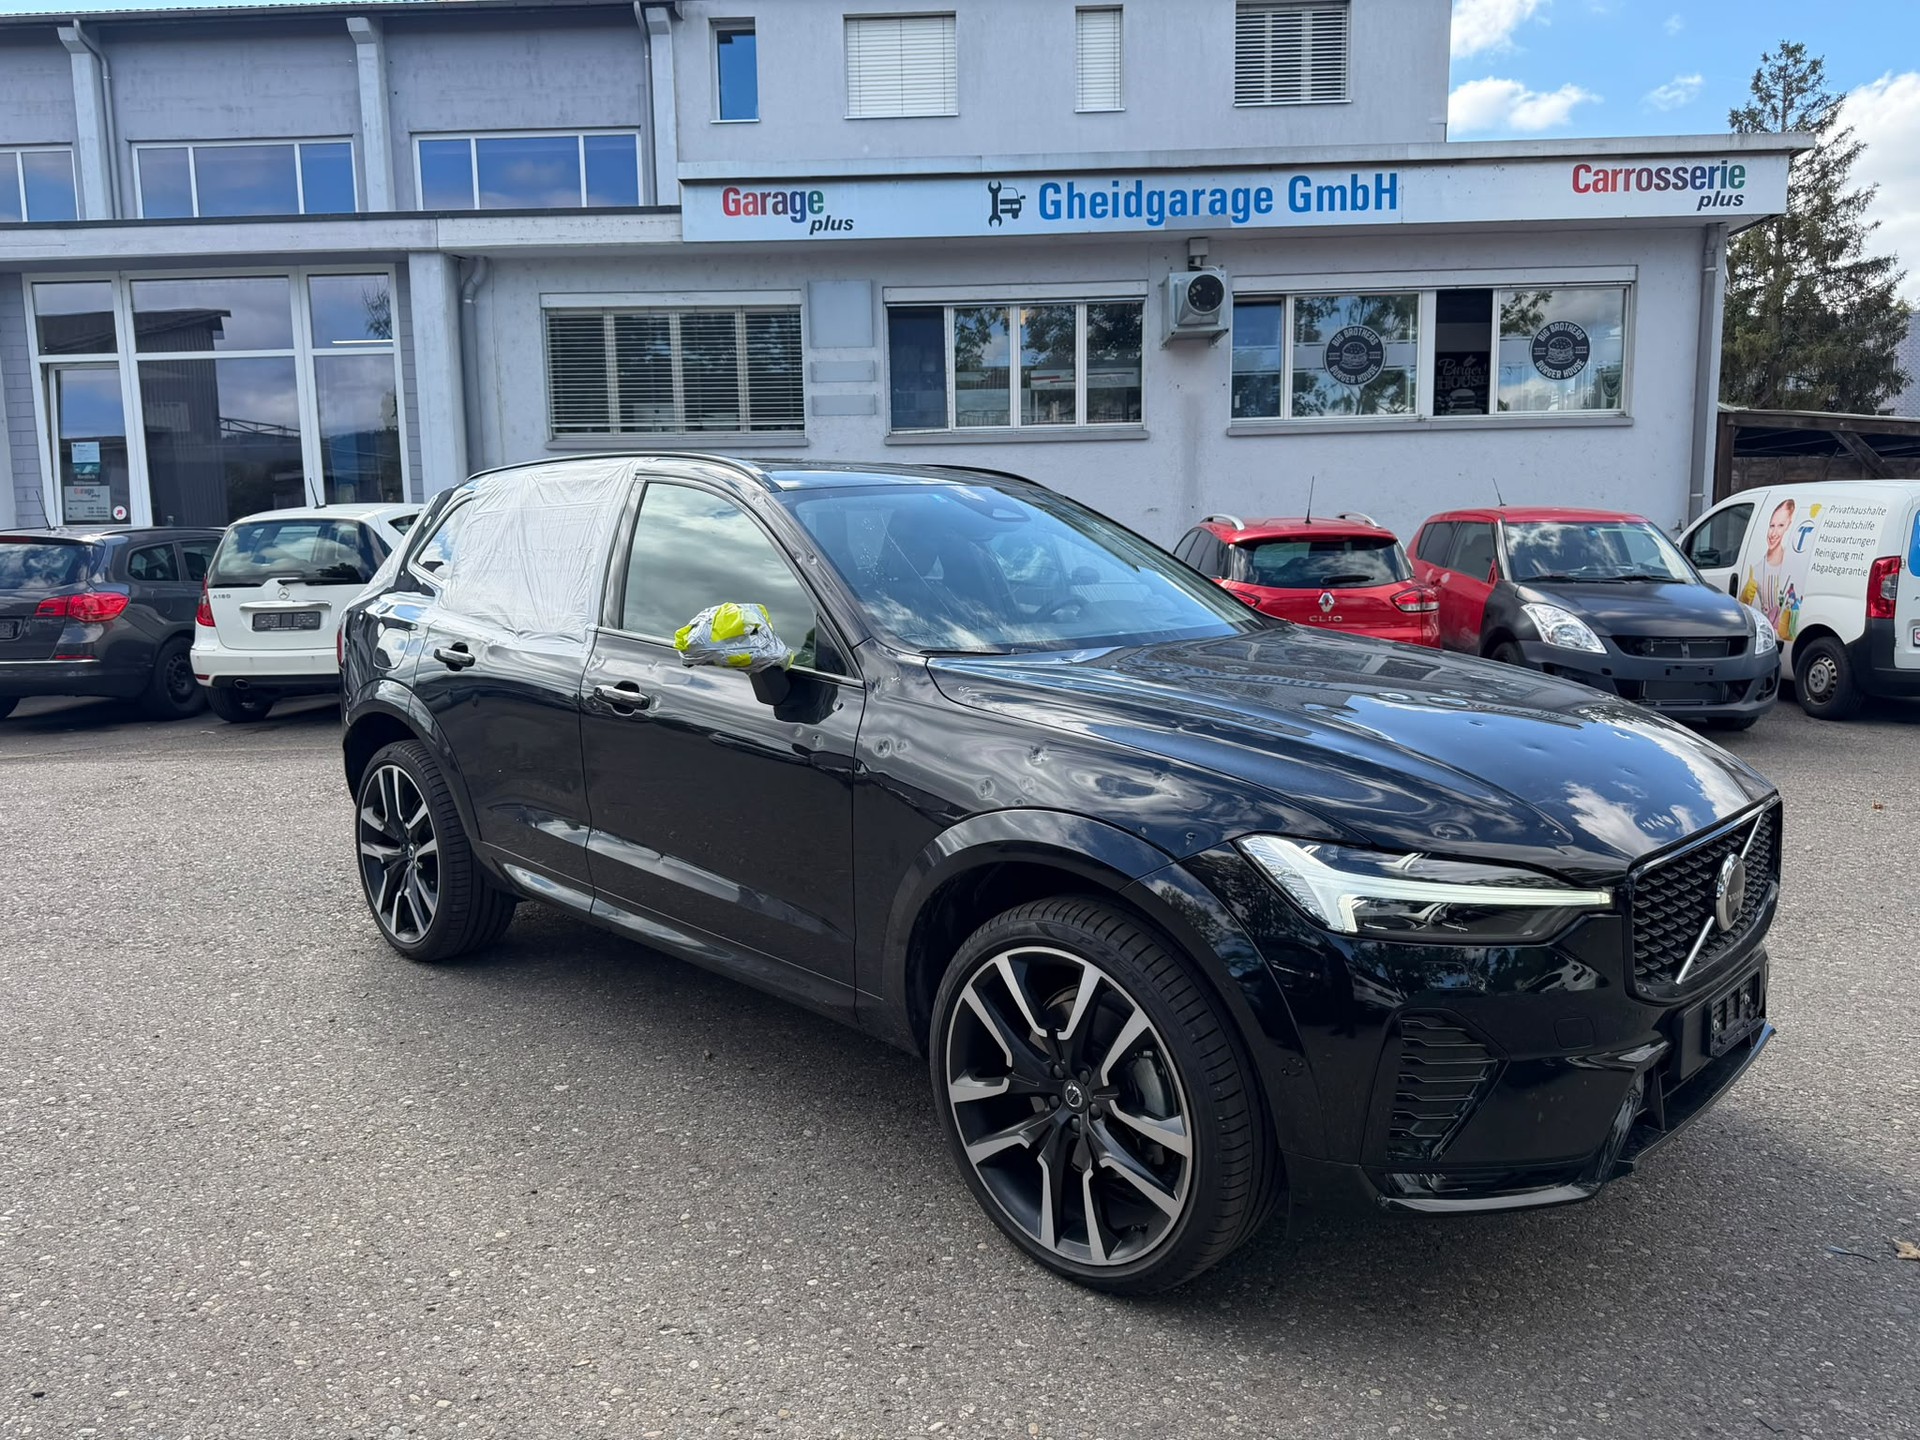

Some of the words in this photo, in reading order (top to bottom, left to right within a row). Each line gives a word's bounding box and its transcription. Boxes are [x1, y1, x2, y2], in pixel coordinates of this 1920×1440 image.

[1572, 159, 1747, 194] Carrosserie
[722, 186, 825, 224] Garage
[1038, 180, 1274, 227] Gheidgarage
[1287, 172, 1398, 214] GmbH
[1696, 190, 1745, 212] plus
[809, 214, 854, 236] plus
[1331, 332, 1345, 347] BIG
[1342, 326, 1379, 346] BROTHERS
[1537, 328, 1551, 342] BIG
[1548, 322, 1586, 341] BROTHERS
[1329, 364, 1357, 384] BURGER
[1356, 363, 1379, 383] HOUSE
[1535, 359, 1562, 379] BURGER
[1562, 357, 1586, 378] HOUSE
[1828, 504, 1887, 516] Privathaushalte
[1822, 519, 1875, 531] Haushaltshilfe
[1818, 533, 1876, 548] Hauswartungen
[1814, 547, 1850, 561] Reinigung
[1850, 551, 1864, 561] mit
[1810, 562, 1868, 577] Abgabegarantie
[1308, 615, 1343, 623] CLIO
